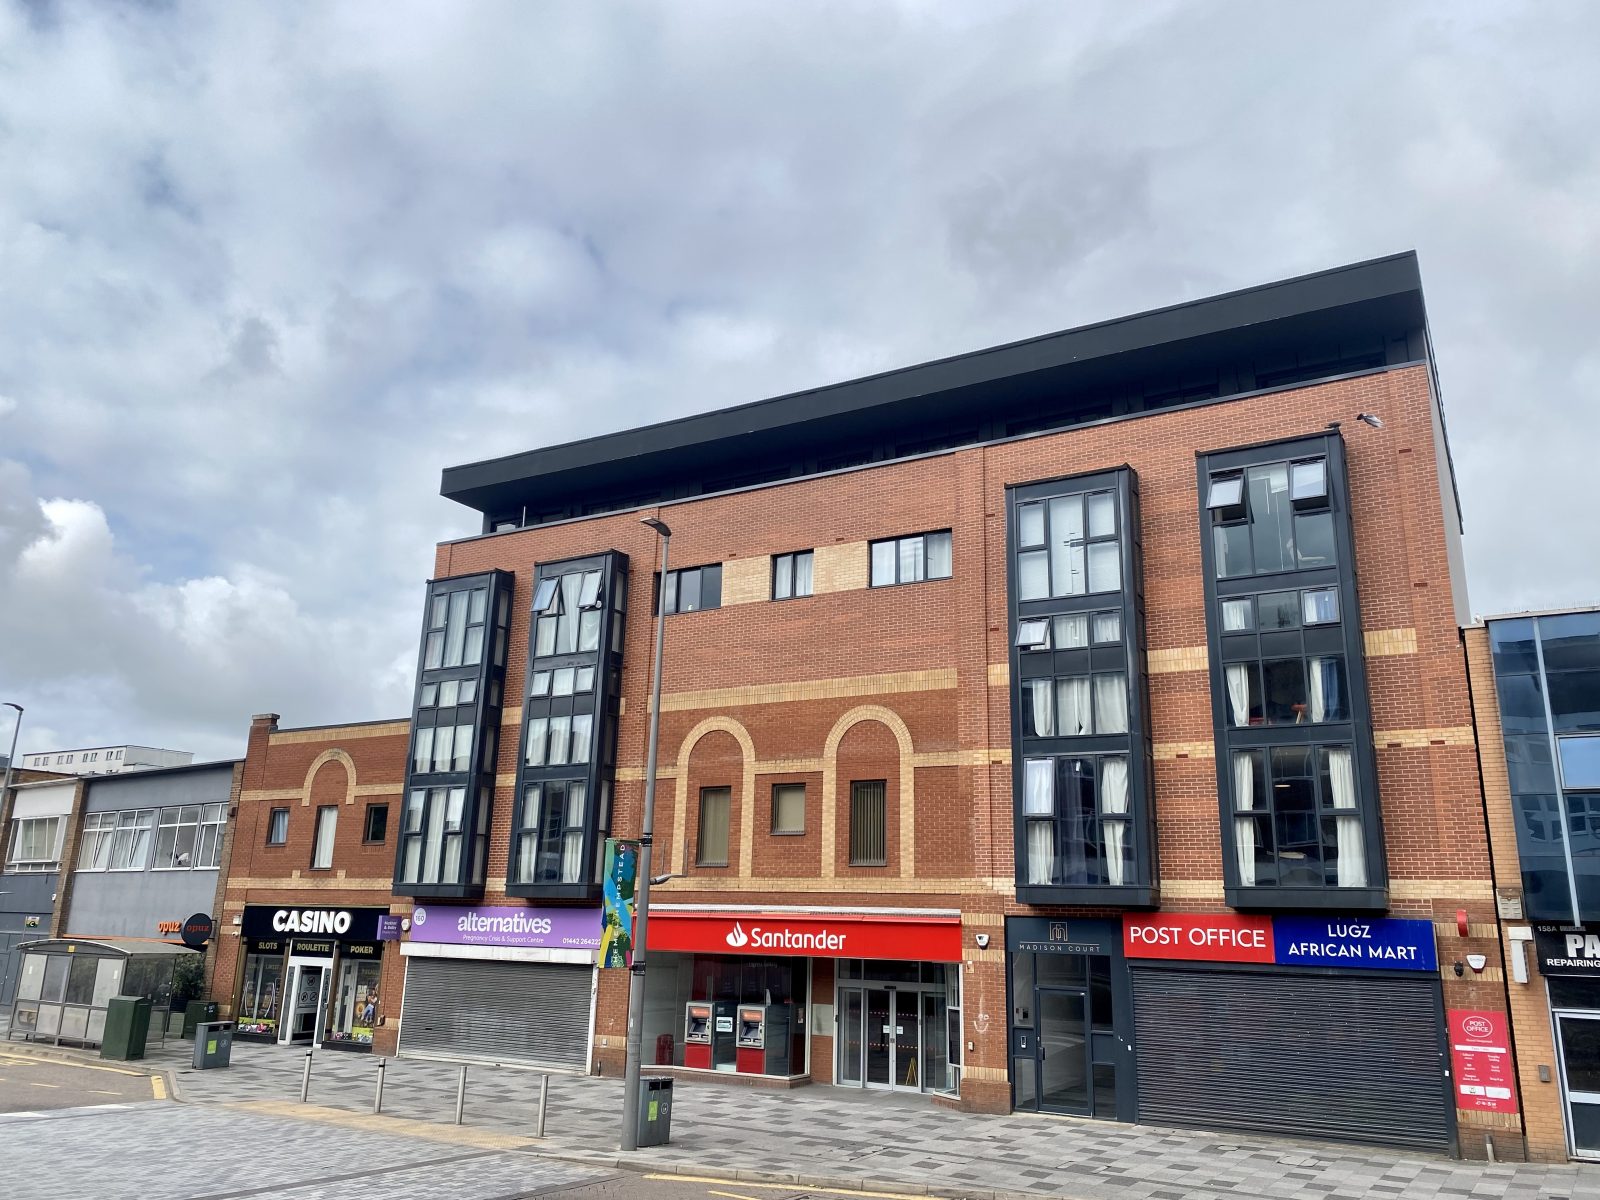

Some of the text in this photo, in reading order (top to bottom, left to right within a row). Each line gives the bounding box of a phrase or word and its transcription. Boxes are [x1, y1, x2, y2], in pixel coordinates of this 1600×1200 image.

[612, 844, 626, 962] HEMEL HEMPSTEAD
[159, 922, 181, 934] opuz
[272, 910, 352, 934] CASINO
[458, 912, 552, 934] alternatives
[187, 925, 209, 934] opuz
[1328, 924, 1371, 938] LUGZ
[462, 934, 488, 942] Pregnancy
[506, 936, 526, 944] Support
[562, 937, 580, 945] 01442
[751, 927, 846, 950] Santander
[1130, 926, 1266, 948] POST OFFICE
[296, 943, 330, 952] ROULETTE
[350, 945, 373, 954] POKER
[1288, 942, 1417, 960] AFRICAN MART
[1565, 934, 1600, 958] PA
[1546, 958, 1600, 968] REPAIRING
